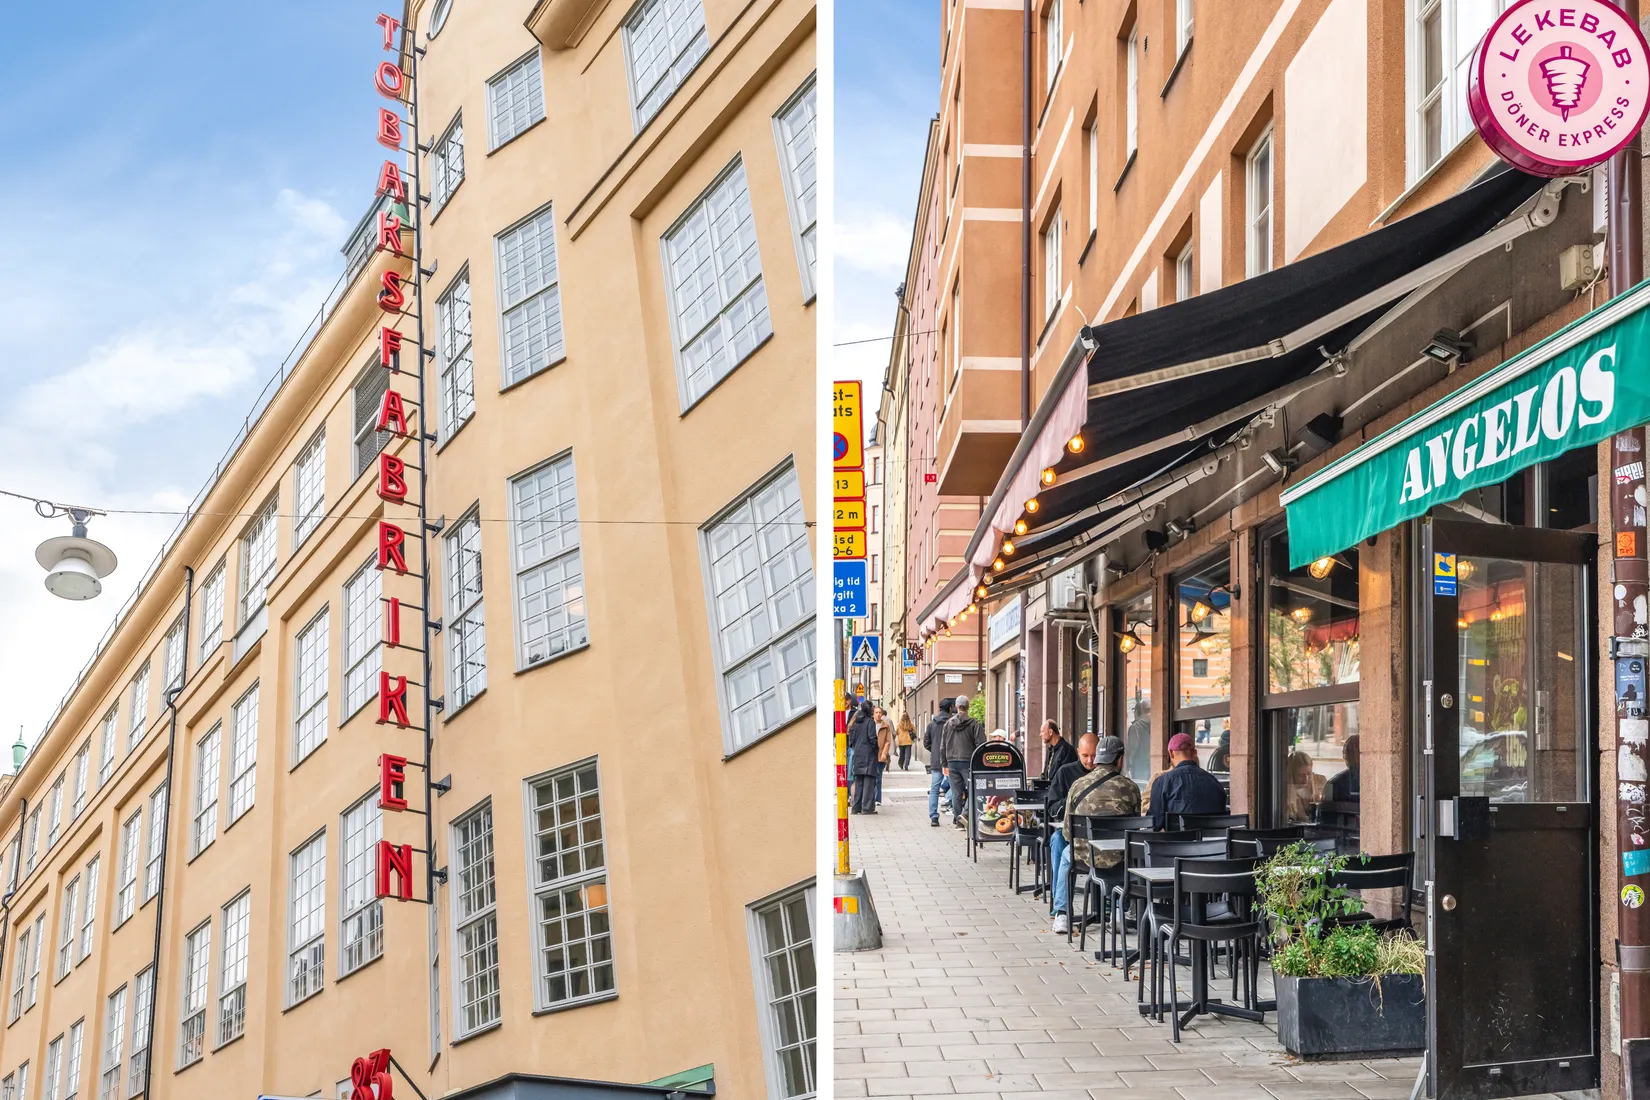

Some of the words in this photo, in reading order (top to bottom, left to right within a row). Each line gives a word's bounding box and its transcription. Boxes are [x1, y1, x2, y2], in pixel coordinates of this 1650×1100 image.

[1500, 90, 1550, 143] DÖNER
[1558, 96, 1630, 147] EXPRESS
[1399, 343, 1617, 505] ANGELOS
[375, 12, 413, 902] TOBAKSFABRIKEN
[848, 511, 858, 519] m
[847, 577, 860, 586] tid
[849, 604, 856, 613] 2
